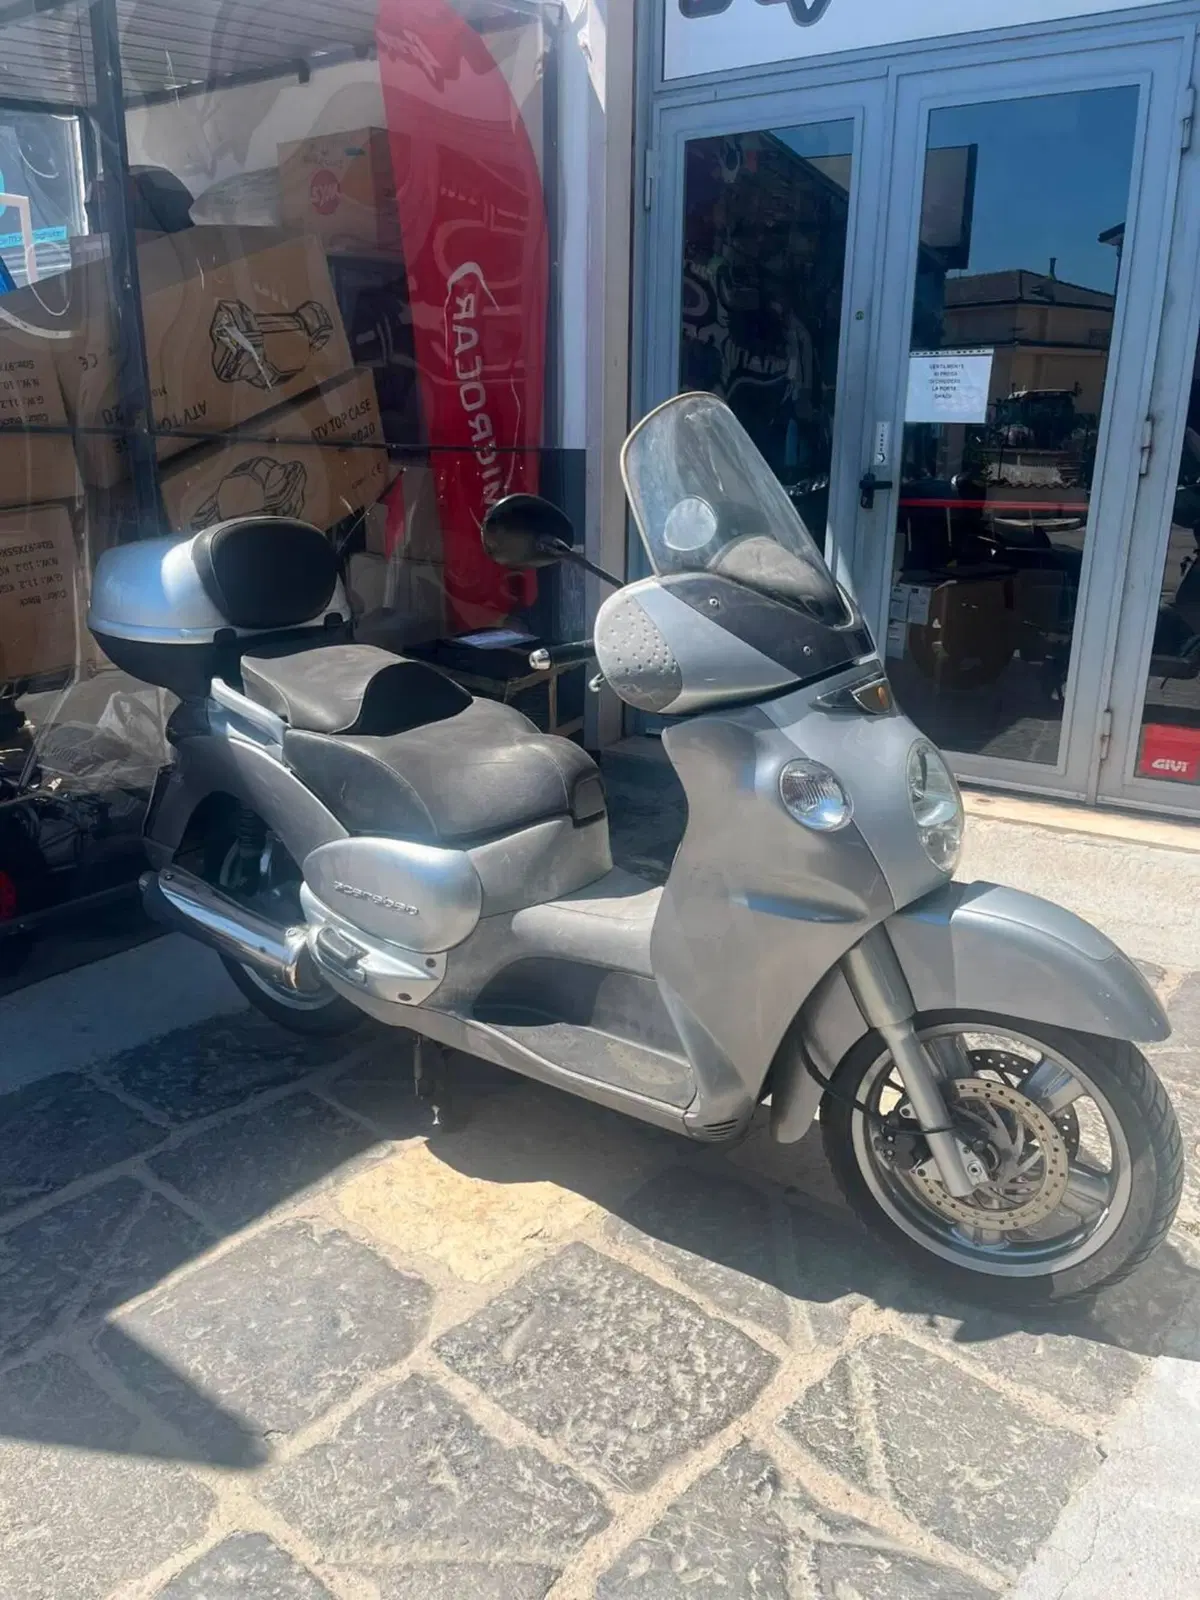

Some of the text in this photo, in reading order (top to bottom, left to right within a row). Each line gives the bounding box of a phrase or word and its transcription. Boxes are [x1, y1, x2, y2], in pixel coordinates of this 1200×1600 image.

[310, 183, 341, 207] SYM
[184, 400, 208, 425] ATV
[328, 412, 348, 433] TOP
[348, 398, 373, 421] CASE
[1151, 758, 1189, 772] GIVI
